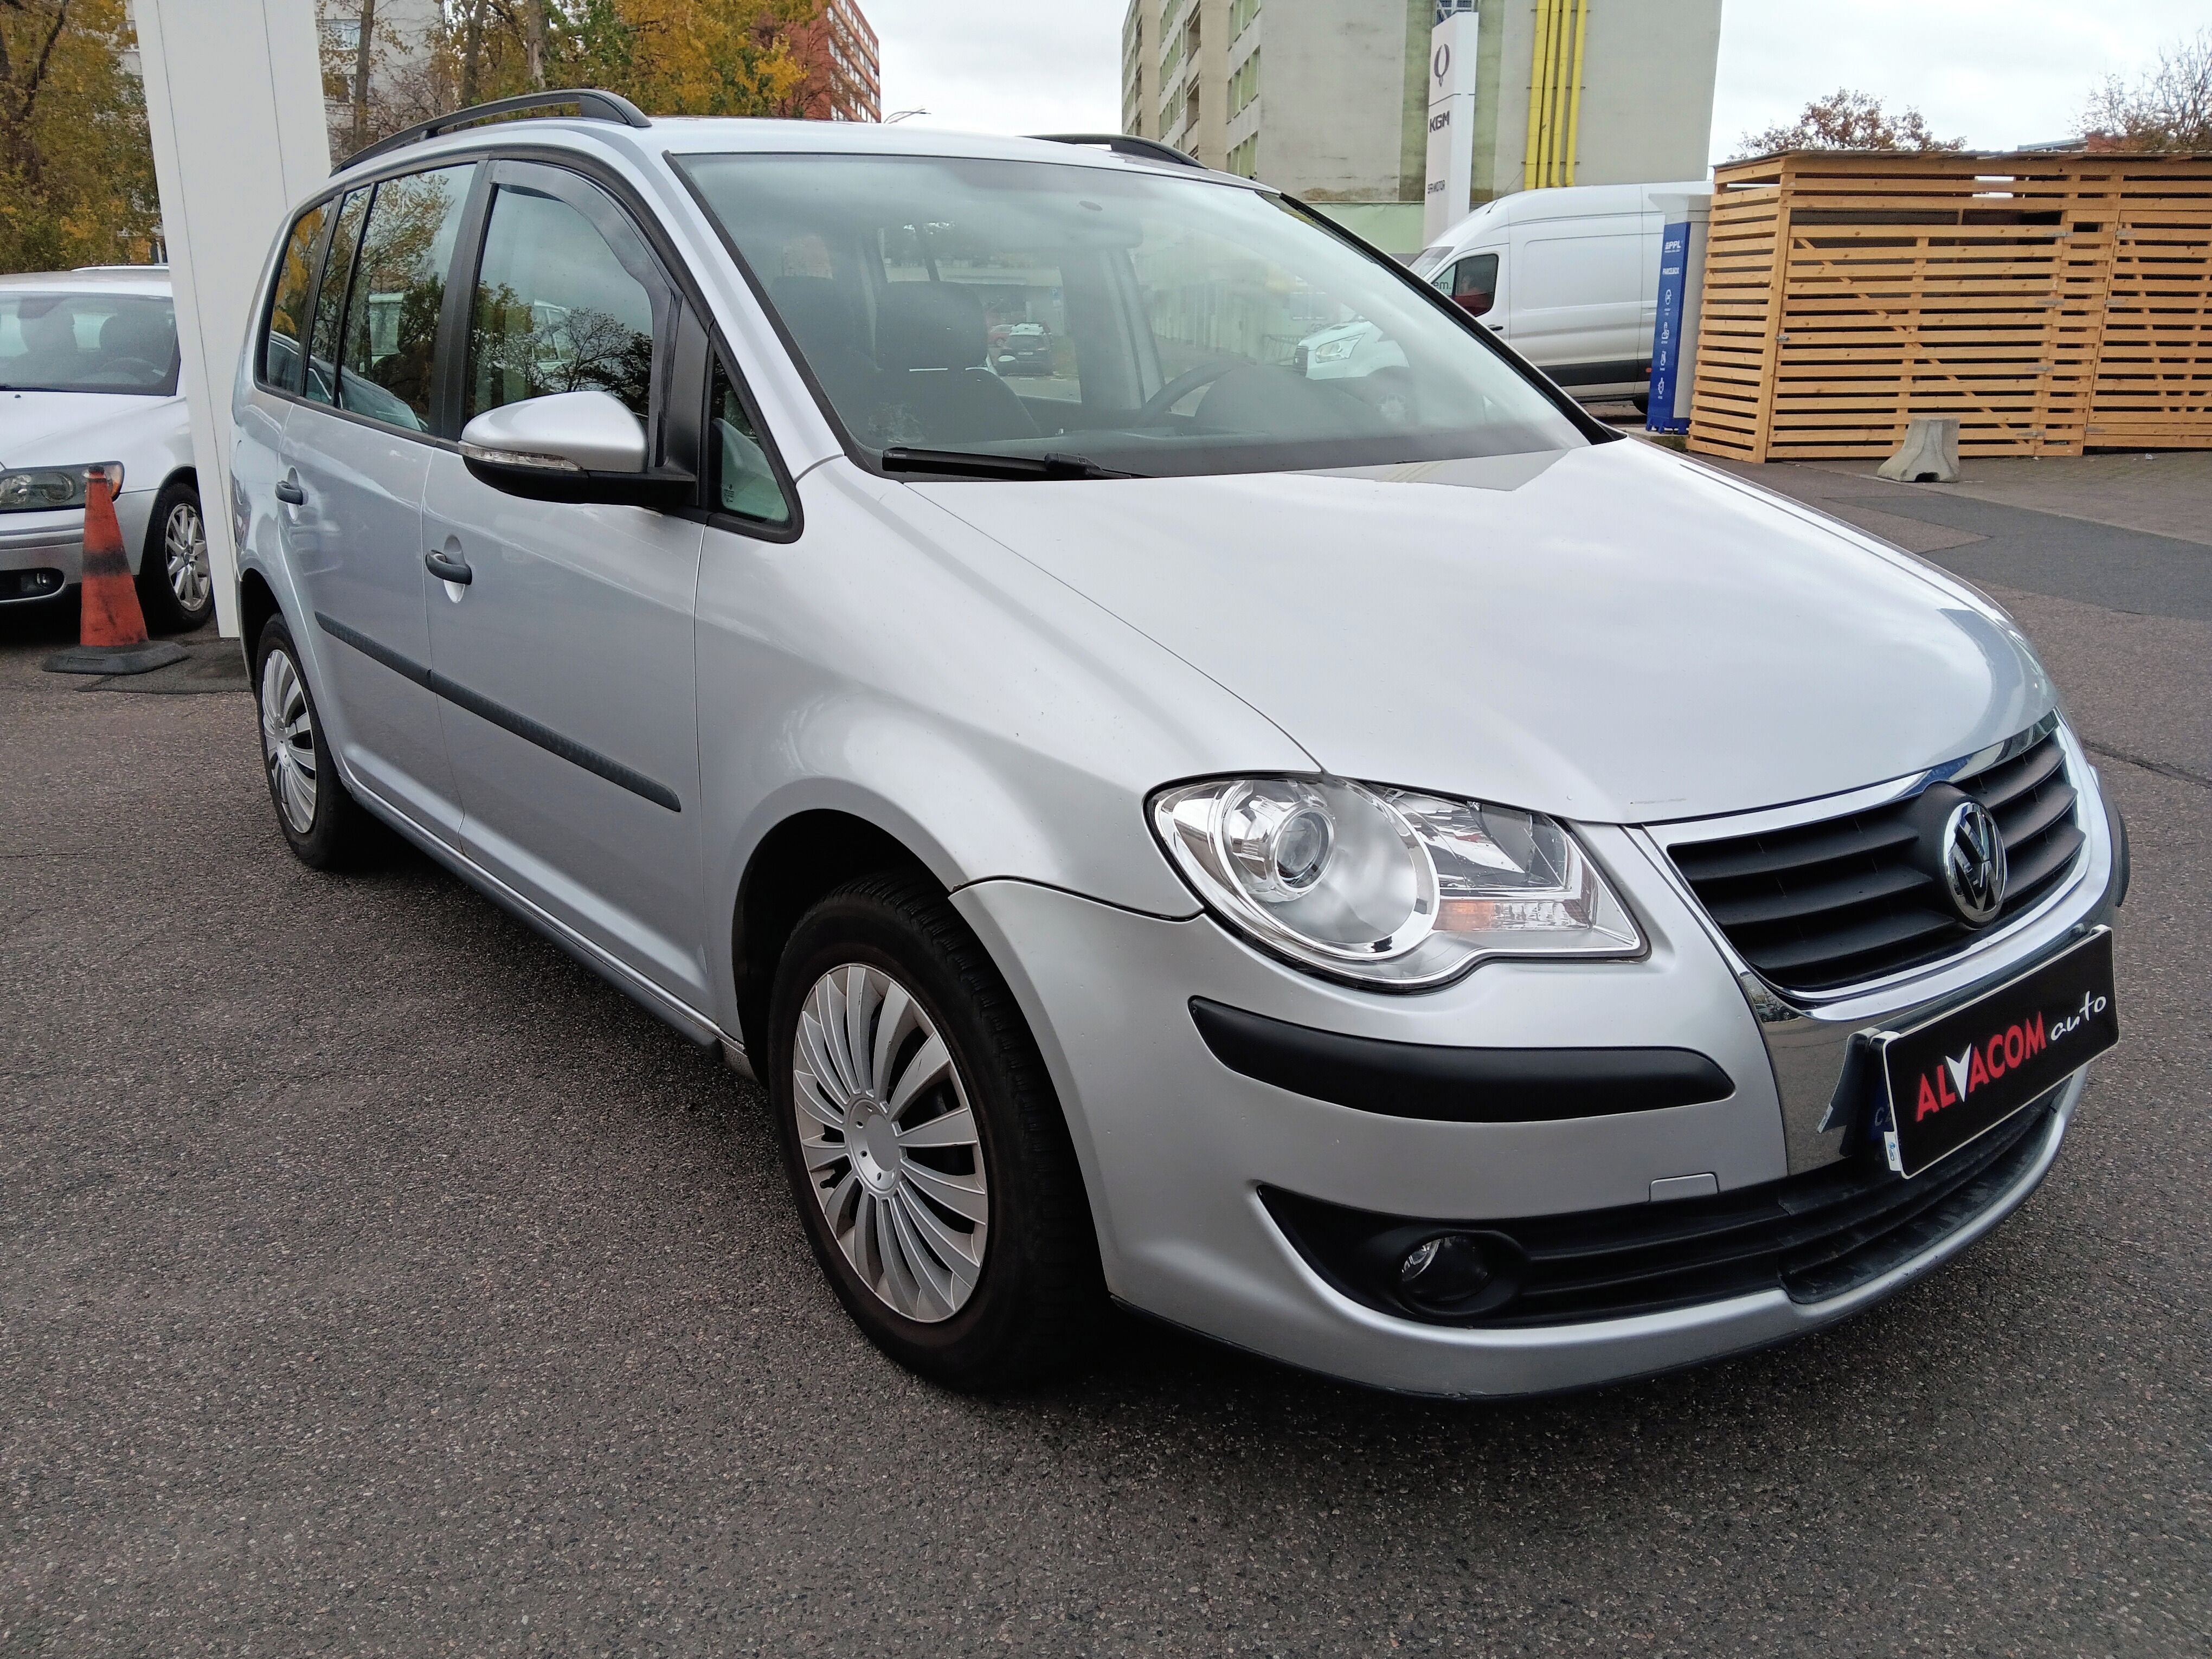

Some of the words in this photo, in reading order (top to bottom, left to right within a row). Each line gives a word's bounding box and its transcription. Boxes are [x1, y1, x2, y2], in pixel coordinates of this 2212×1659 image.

[1429, 110, 1450, 133] KGM
[1668, 240, 1681, 249] PPL
[1916, 1011, 2046, 1121] ALVACOM
[2050, 990, 2106, 1041] auto
